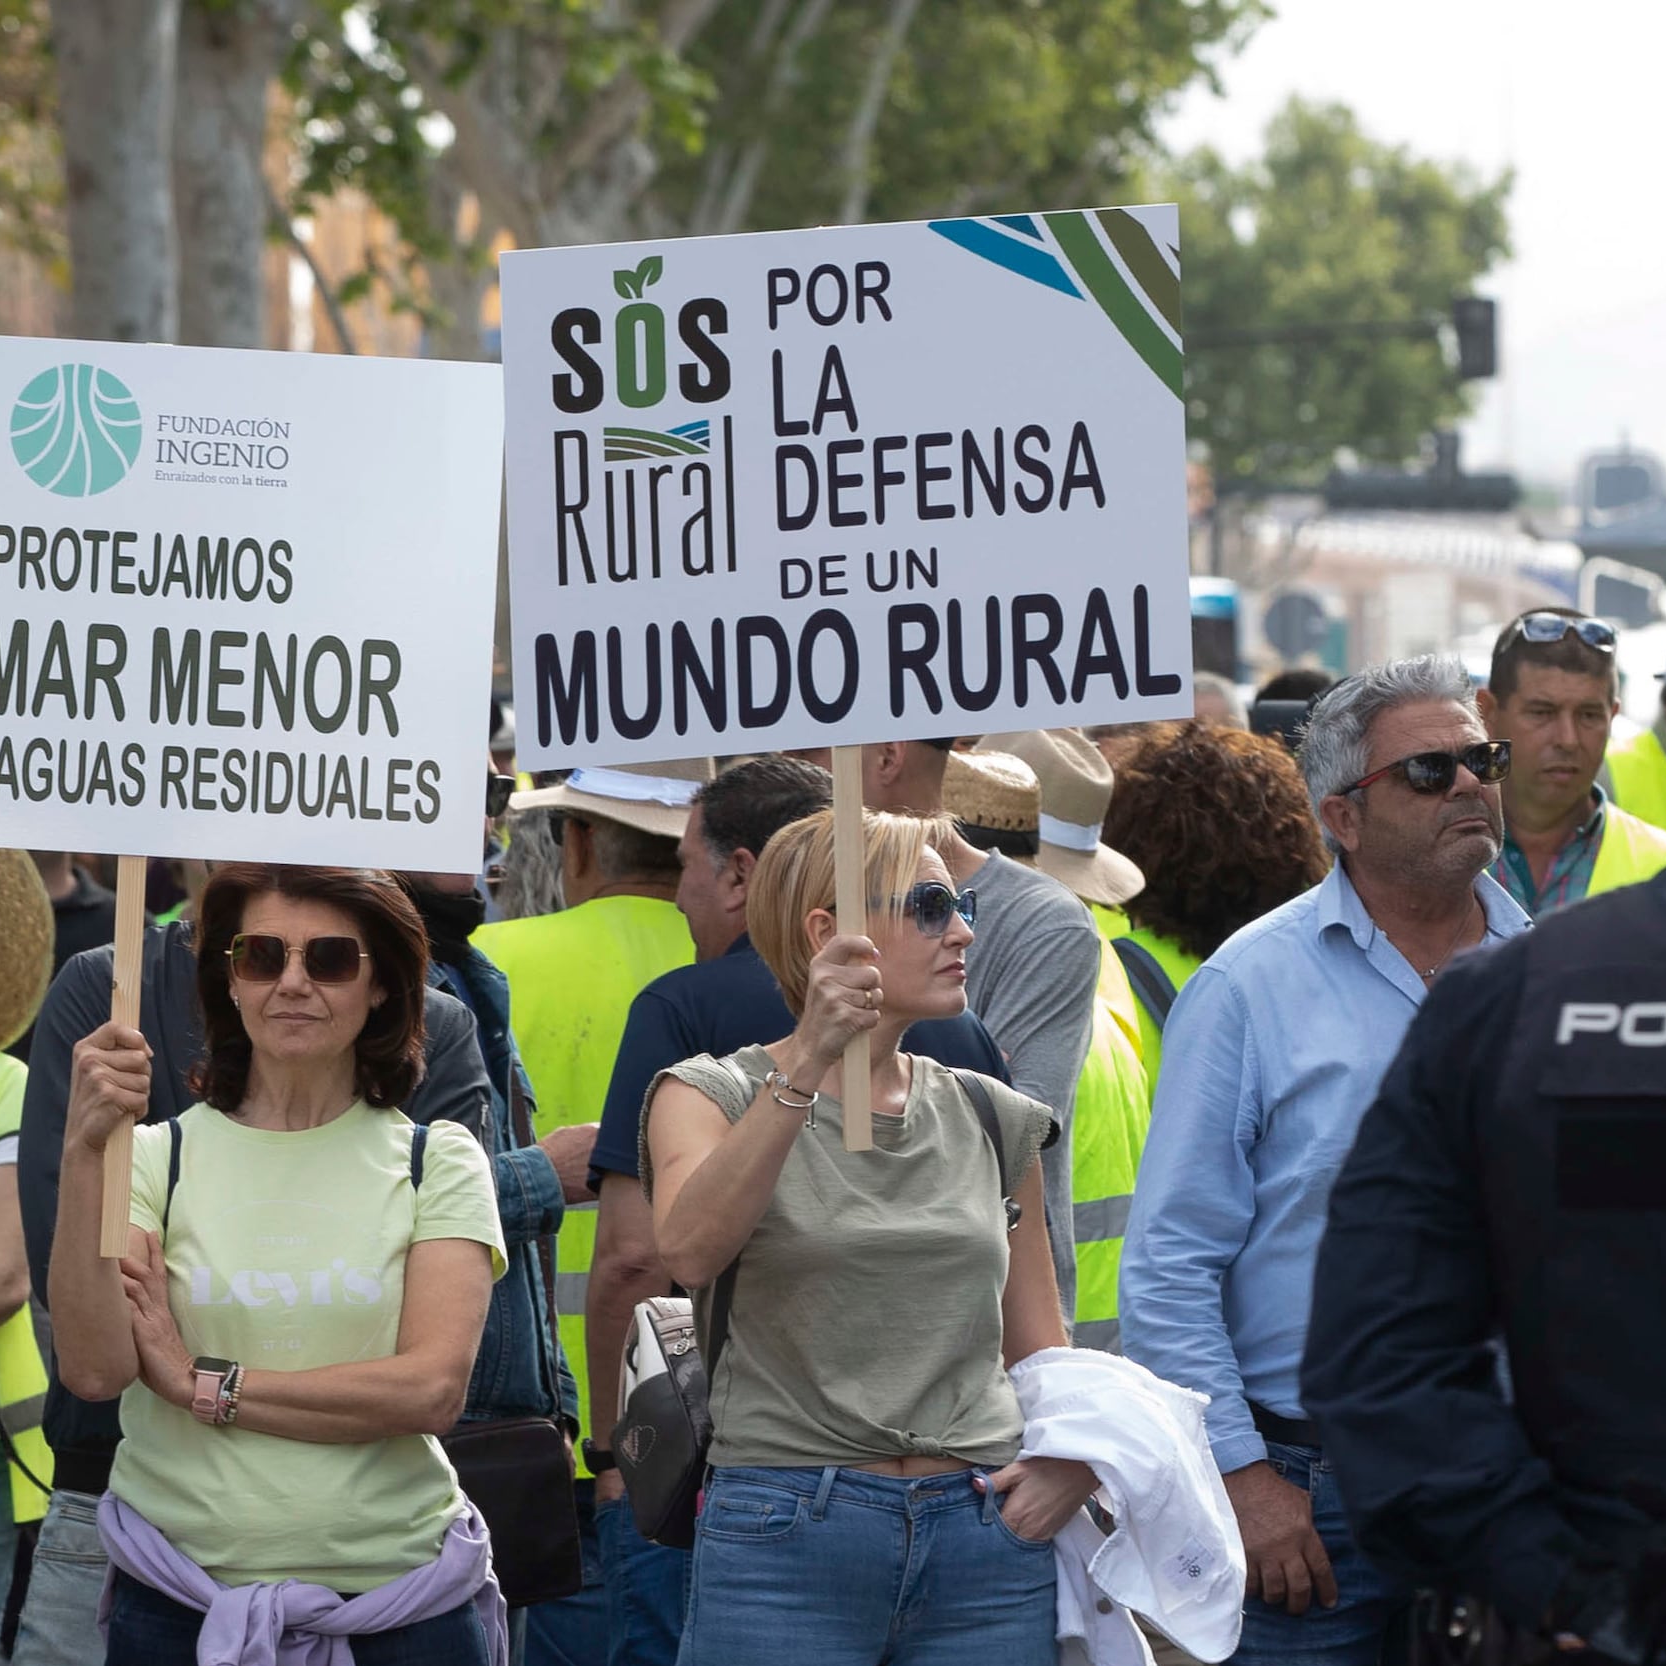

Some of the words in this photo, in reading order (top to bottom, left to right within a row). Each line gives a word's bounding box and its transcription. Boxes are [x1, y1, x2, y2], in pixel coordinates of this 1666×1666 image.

[768, 261, 892, 330] POR
[551, 298, 731, 414] SOS
[772, 345, 858, 436] LA
[155, 439, 289, 469] INGENIO
[157, 414, 291, 439] FUNDACIÓN
[219, 476, 239, 484] con
[242, 474, 252, 486] la
[255, 476, 288, 487] tierra
[554, 415, 736, 586] Rural
[776, 421, 1105, 531] DEFENSA
[780, 555, 848, 599] DE
[866, 547, 938, 592] UN
[150, 627, 401, 737] MENOR
[535, 608, 859, 748] MUNDO
[888, 584, 1181, 718] RURAL
[161, 746, 440, 823] RESIDUALES
[190, 1257, 382, 1306] Levi's
